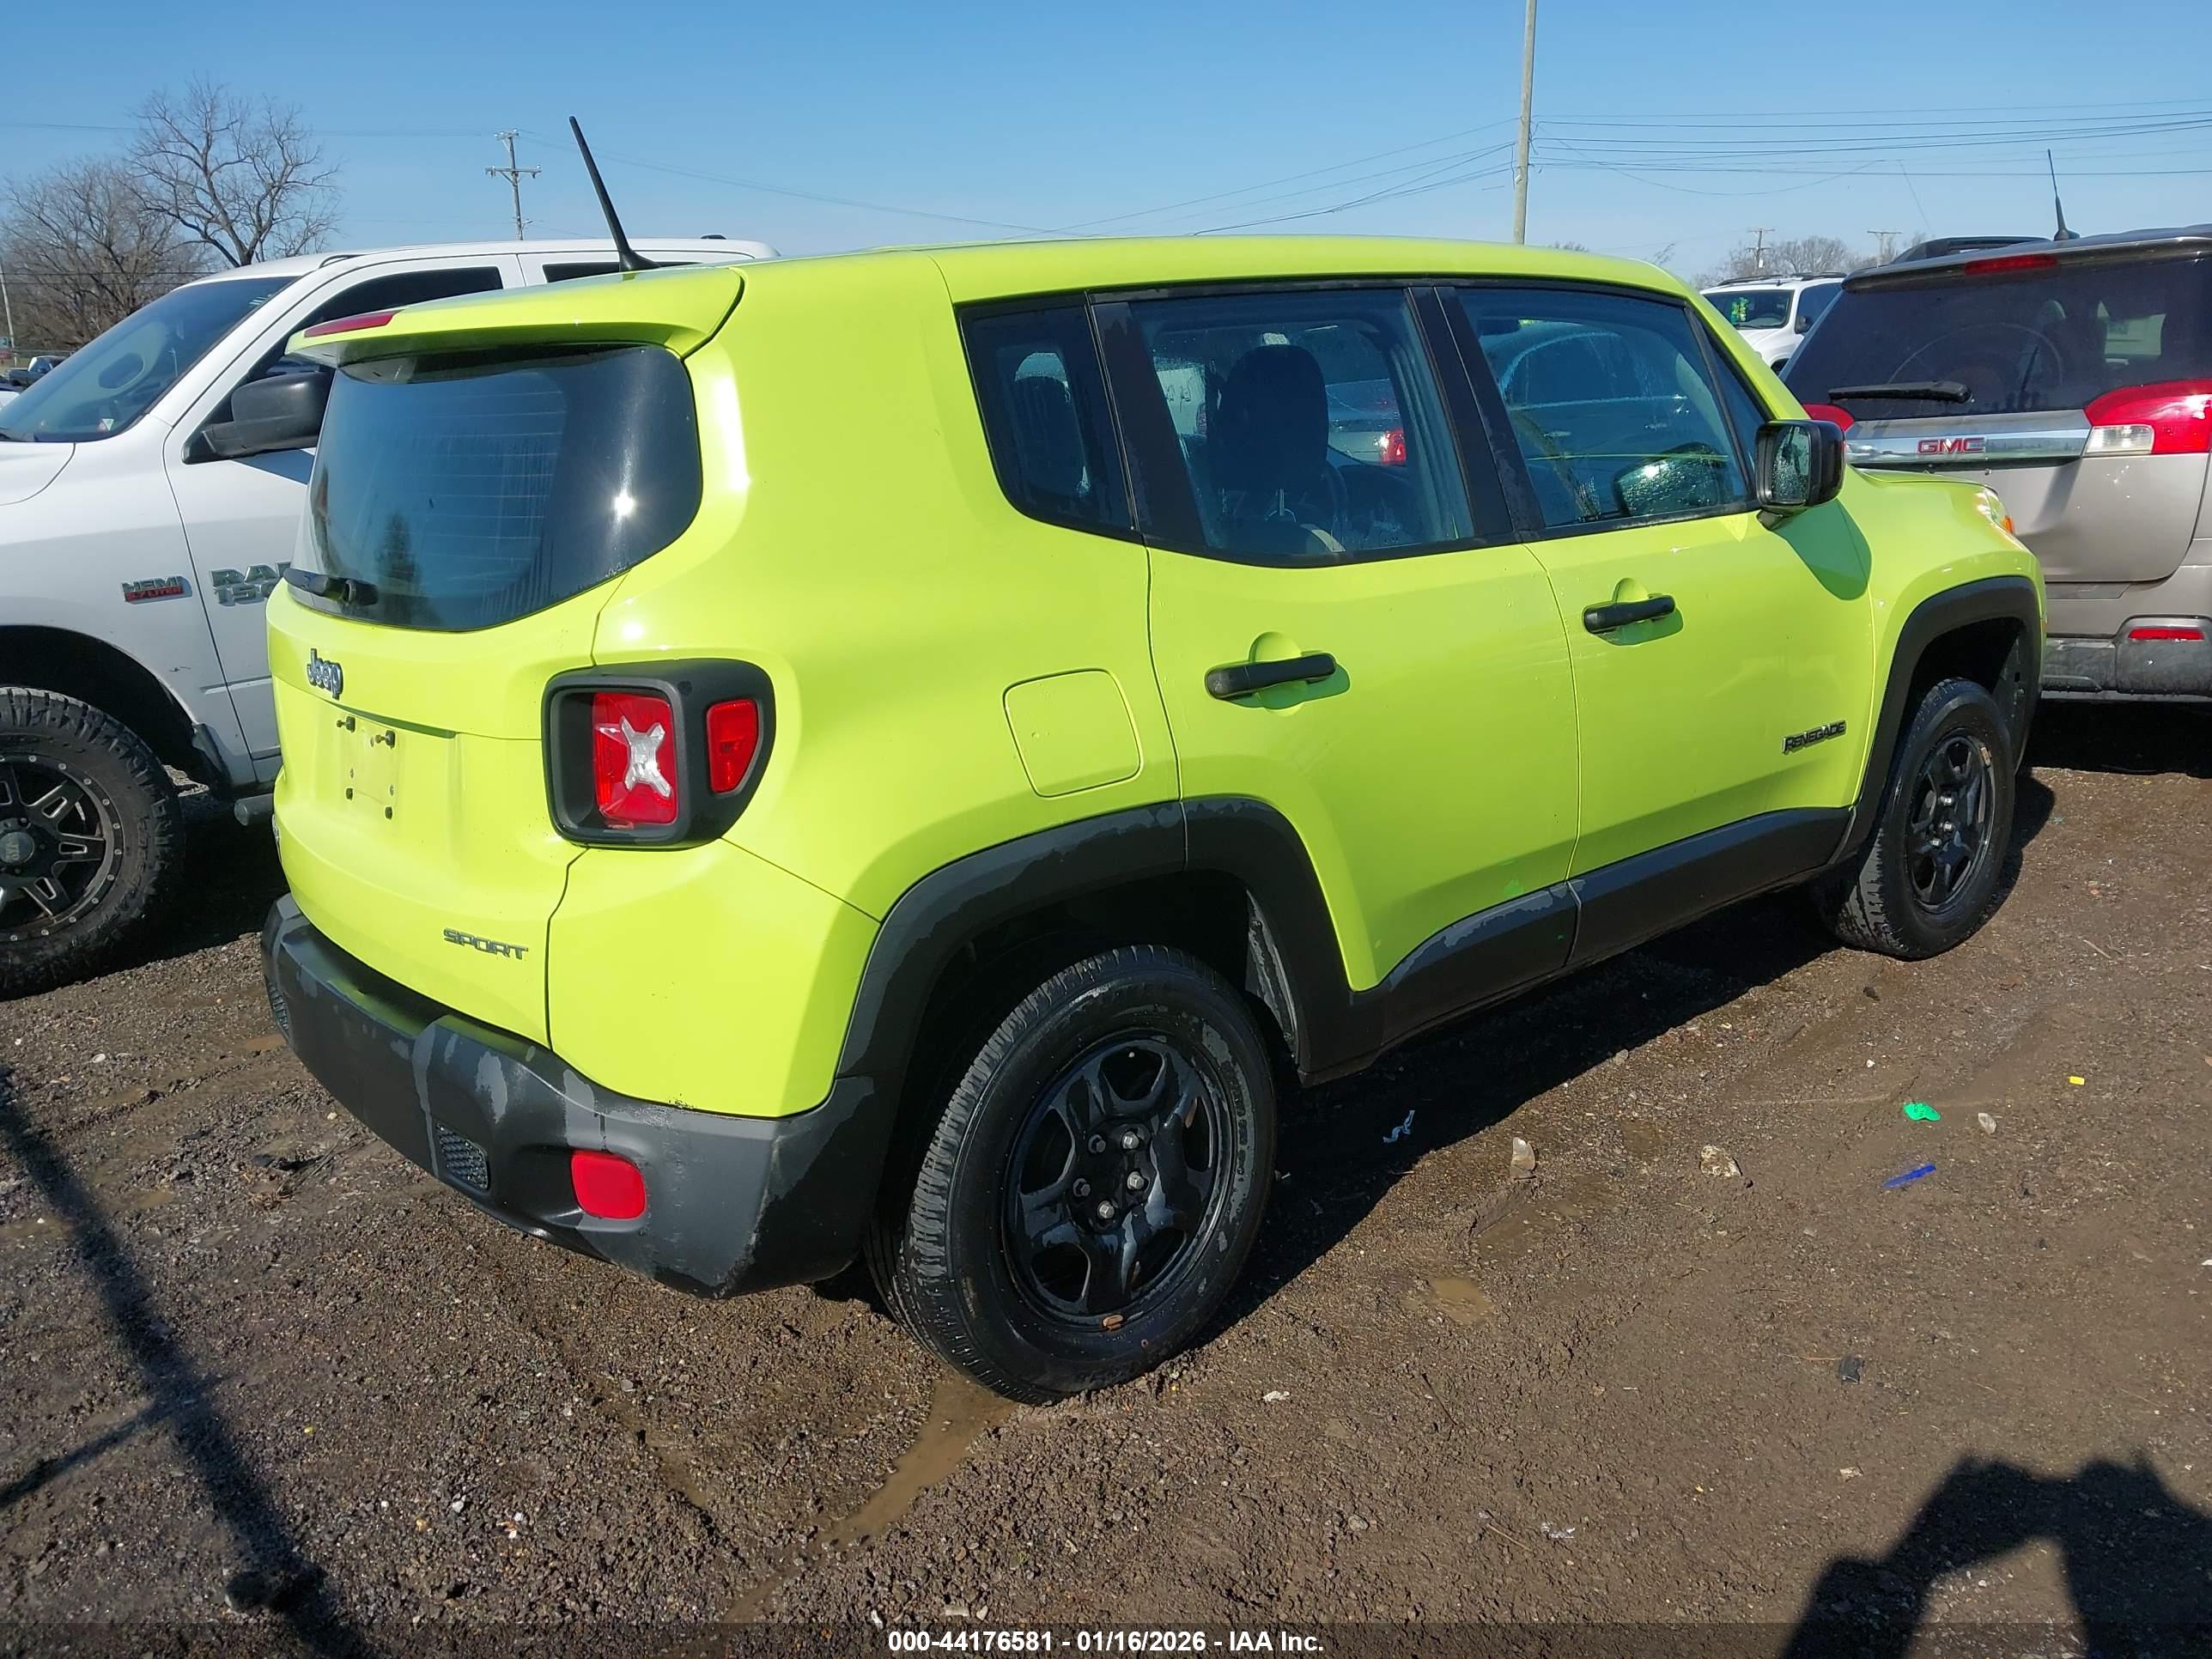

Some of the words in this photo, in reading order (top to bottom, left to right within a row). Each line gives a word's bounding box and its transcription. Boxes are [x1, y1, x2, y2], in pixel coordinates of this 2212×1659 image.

[1917, 437, 1986, 454] GMC
[122, 575, 181, 592] HEMI
[149, 586, 184, 599] LITER
[307, 647, 343, 701] Jeep
[1781, 720, 1847, 756] RENEGADE
[443, 927, 529, 960] SPORT
